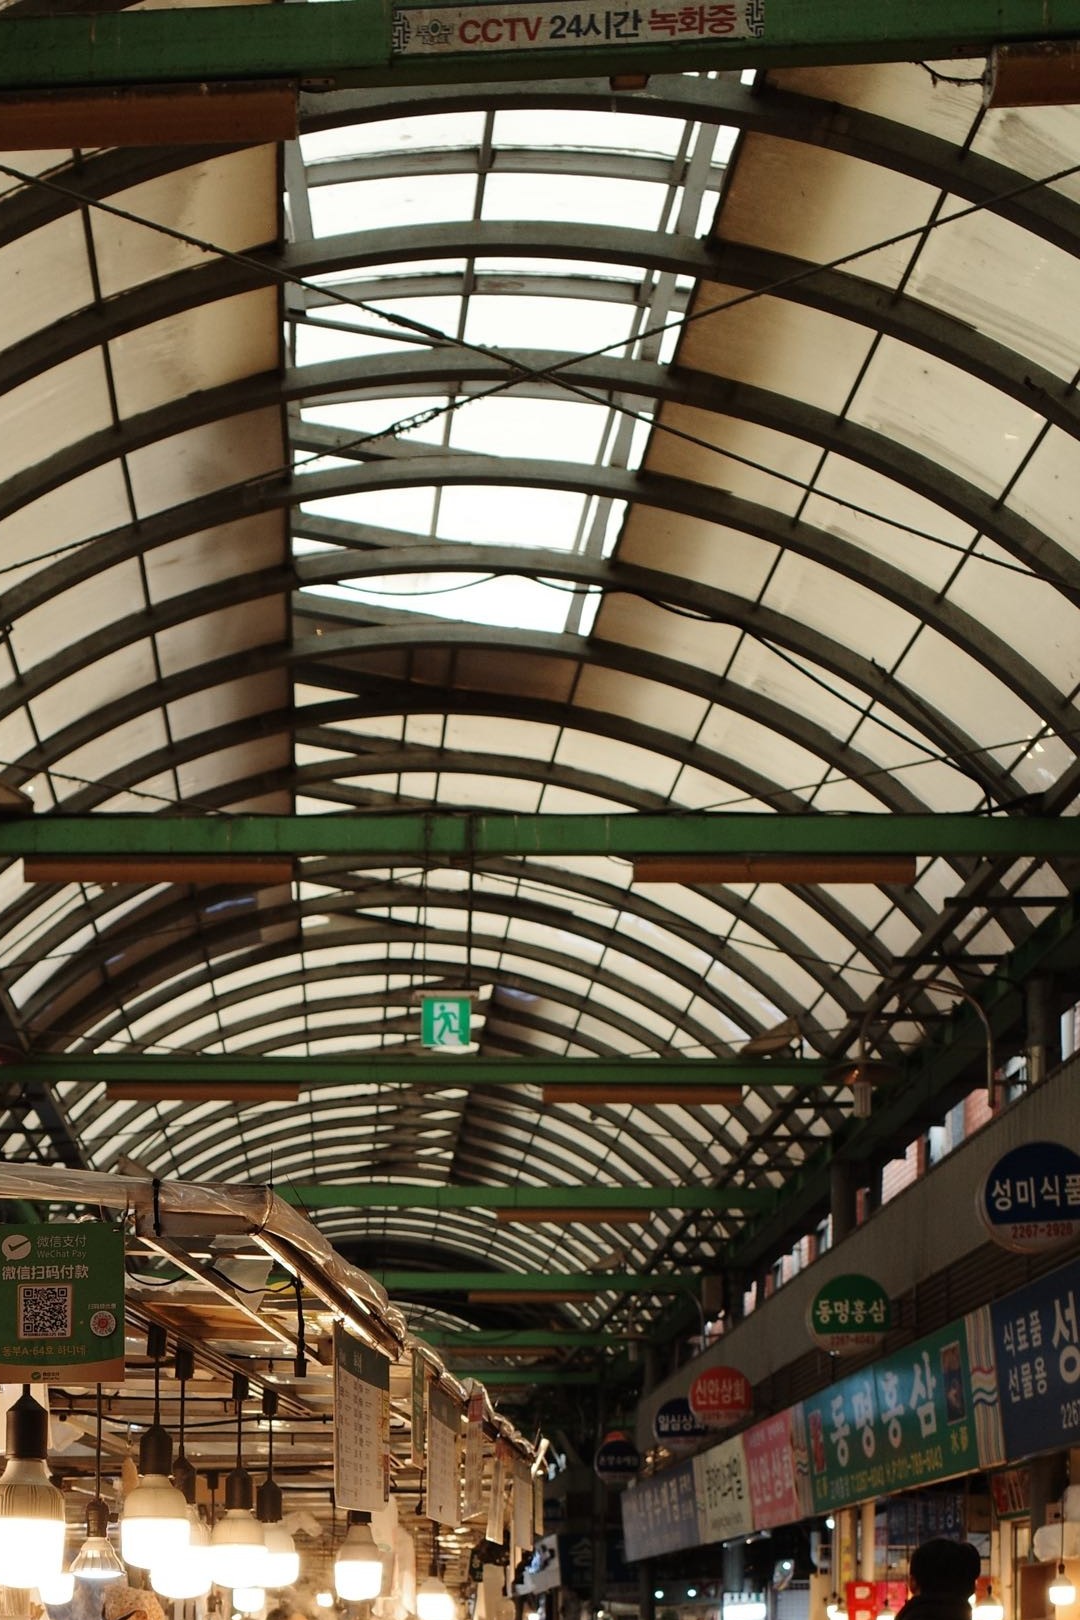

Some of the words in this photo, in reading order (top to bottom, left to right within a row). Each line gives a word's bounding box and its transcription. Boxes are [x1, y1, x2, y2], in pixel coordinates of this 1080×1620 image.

[459, 17, 542, 44] CCTV
[549, 9, 642, 39] 24시간
[648, 5, 737, 35] 녹화중
[991, 1174, 1080, 1212] 성미식품
[36, 1235, 86, 1248] 微信支付
[37, 1250, 69, 1259] WeChat
[72, 1250, 87, 1259] Pay
[1, 1265, 89, 1280] 微信扫码付款
[815, 1298, 887, 1325] 동명홍삼
[1003, 1309, 1042, 1358] 식료품
[57, 1345, 86, 1357] 하니네
[695, 1377, 745, 1405] 신안상회
[1008, 1356, 1047, 1403] 선물용
[830, 1350, 937, 1468] 동명홍삼
